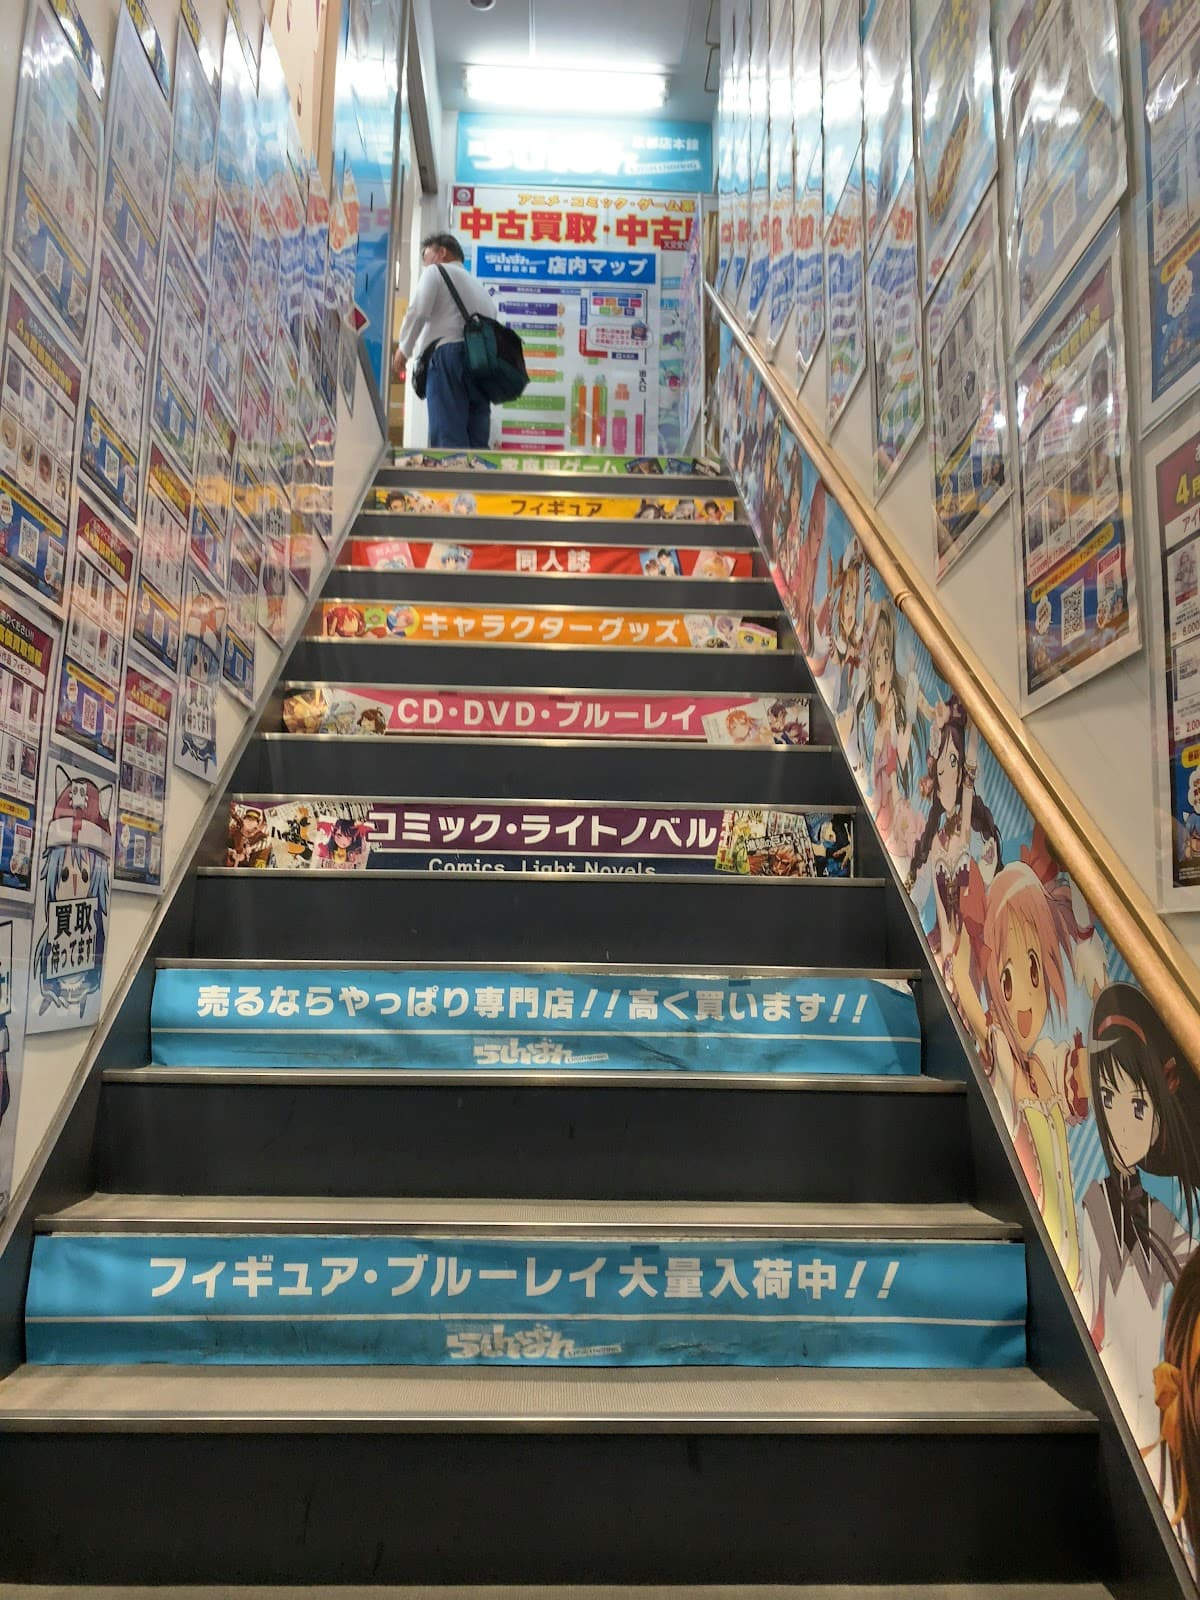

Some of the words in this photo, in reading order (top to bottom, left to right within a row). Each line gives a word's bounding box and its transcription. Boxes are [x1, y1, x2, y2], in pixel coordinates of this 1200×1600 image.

[460, 208, 694, 246] 中古買取・中古
[547, 255, 649, 277] 店内マップ
[501, 457, 618, 474] 家庭用ゲーム
[511, 499, 603, 518] フィギュア
[516, 549, 591, 572] 同人誌
[422, 612, 681, 643] キャラクターグッズ
[397, 698, 697, 731] CD・DVD・ブルーレイ
[367, 811, 718, 848] コミック・ライトノベル
[54, 902, 93, 941] 買取
